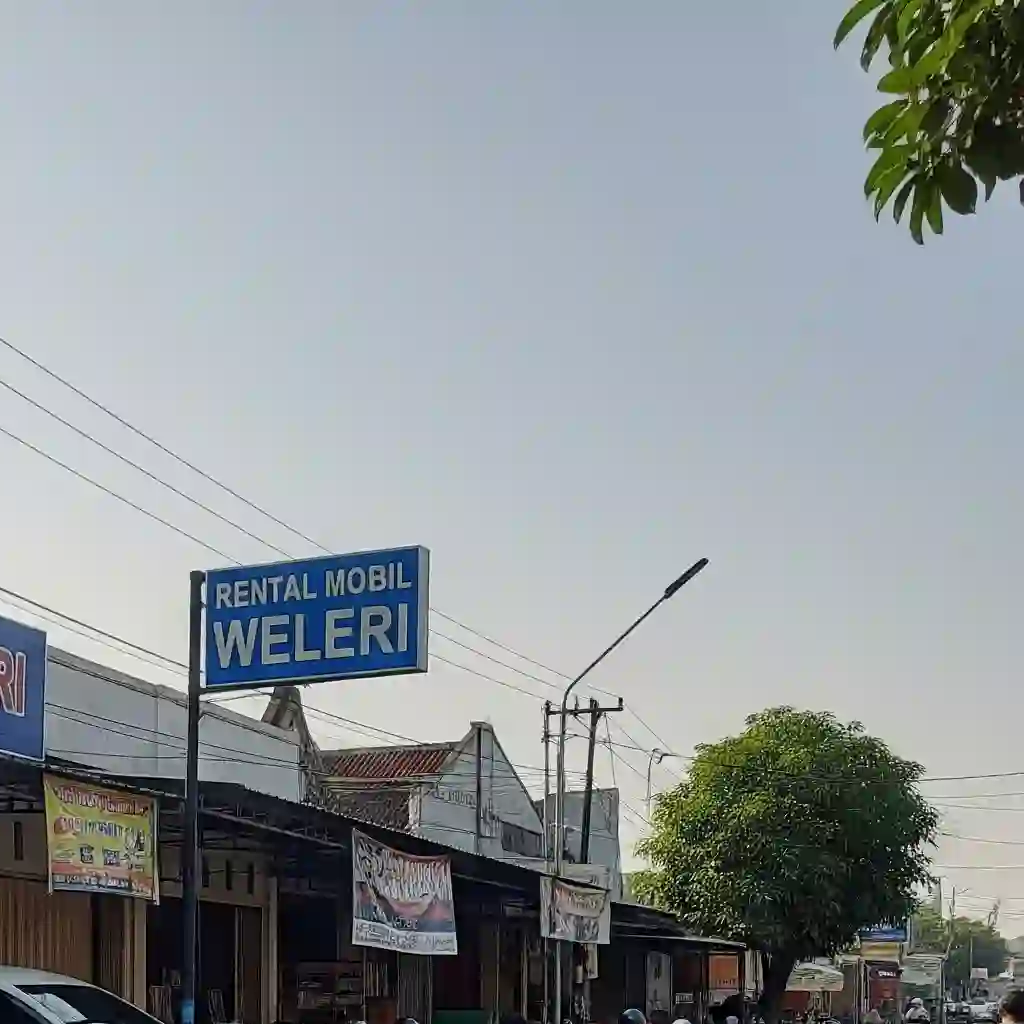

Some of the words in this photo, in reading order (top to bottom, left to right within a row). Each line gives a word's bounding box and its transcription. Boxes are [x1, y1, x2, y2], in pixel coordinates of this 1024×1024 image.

[215, 573, 317, 610] RENTAL
[325, 561, 412, 598] MOBIL
[213, 603, 408, 669] WELERI
